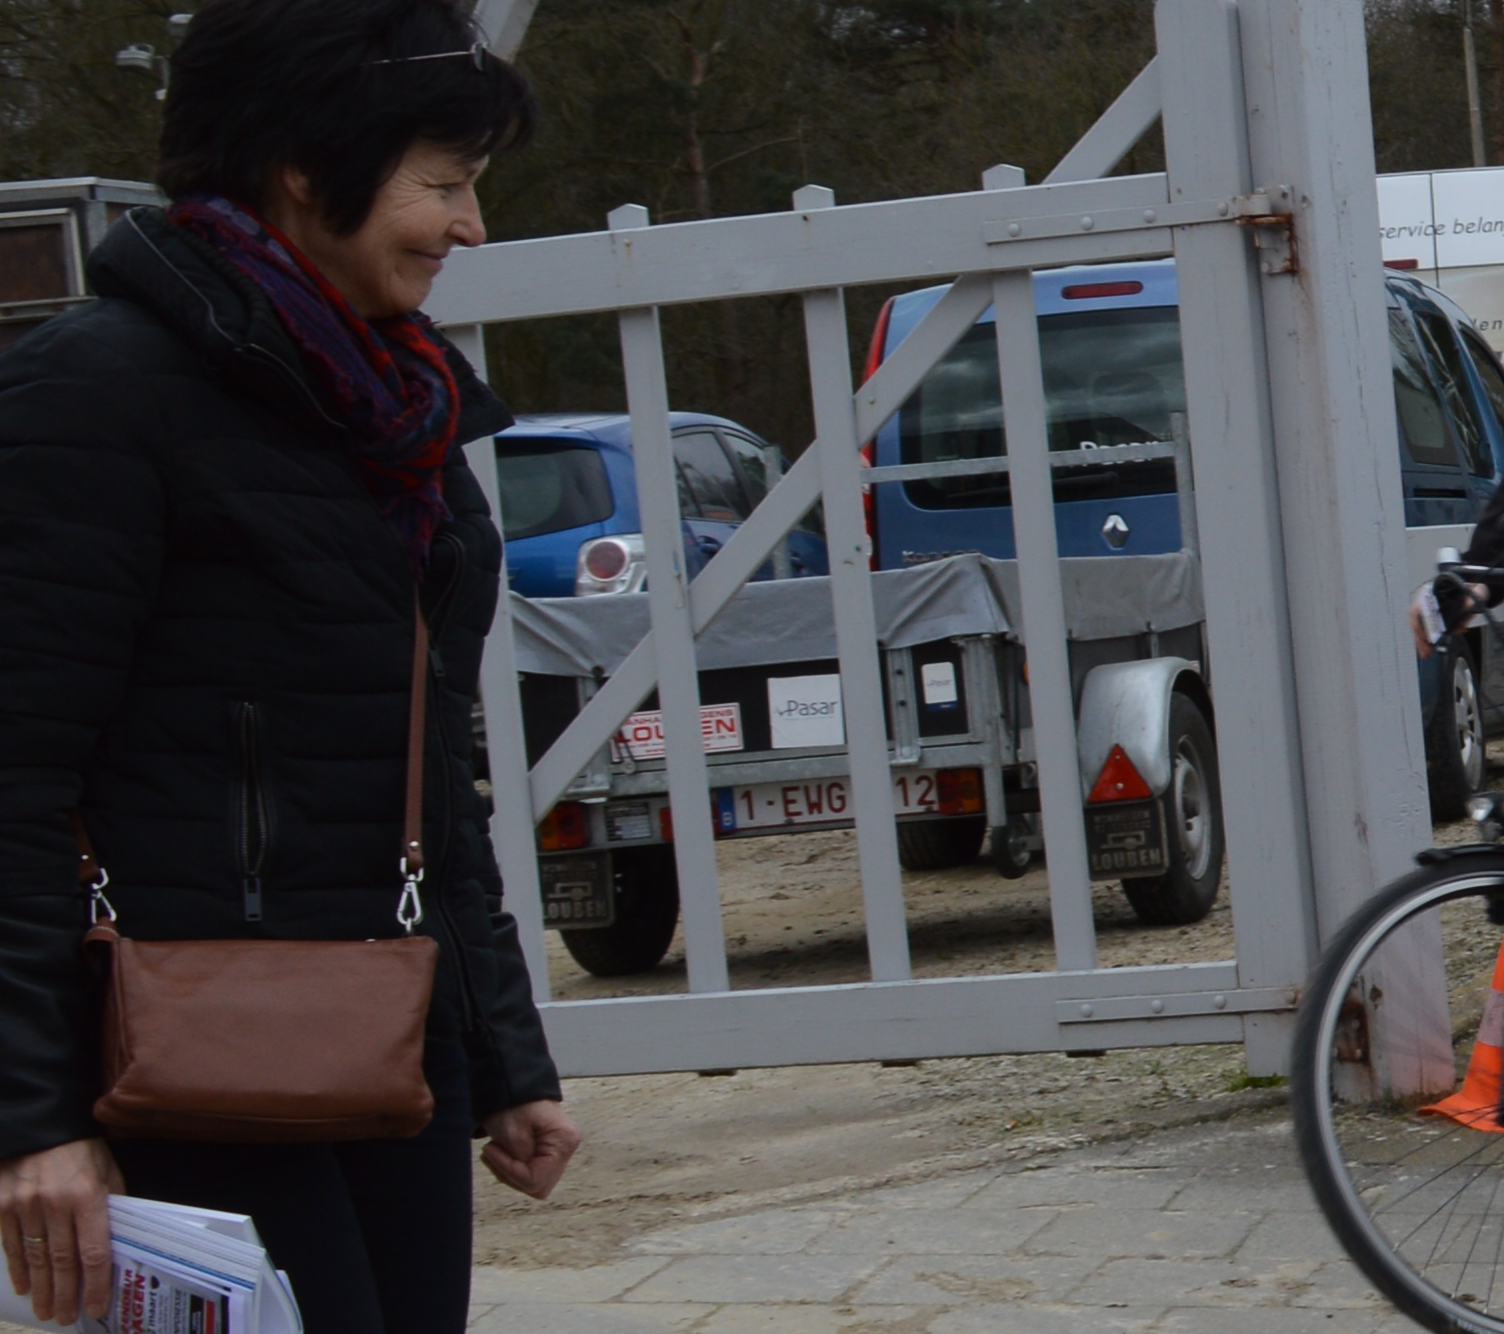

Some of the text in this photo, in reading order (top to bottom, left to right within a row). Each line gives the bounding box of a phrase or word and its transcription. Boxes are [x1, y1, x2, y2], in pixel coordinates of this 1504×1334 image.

[1379, 220, 1445, 239] service
[787, 699, 838, 717] Pasar
[545, 899, 608, 920] OUBEN
[148, 1289, 157, 1326] maart
